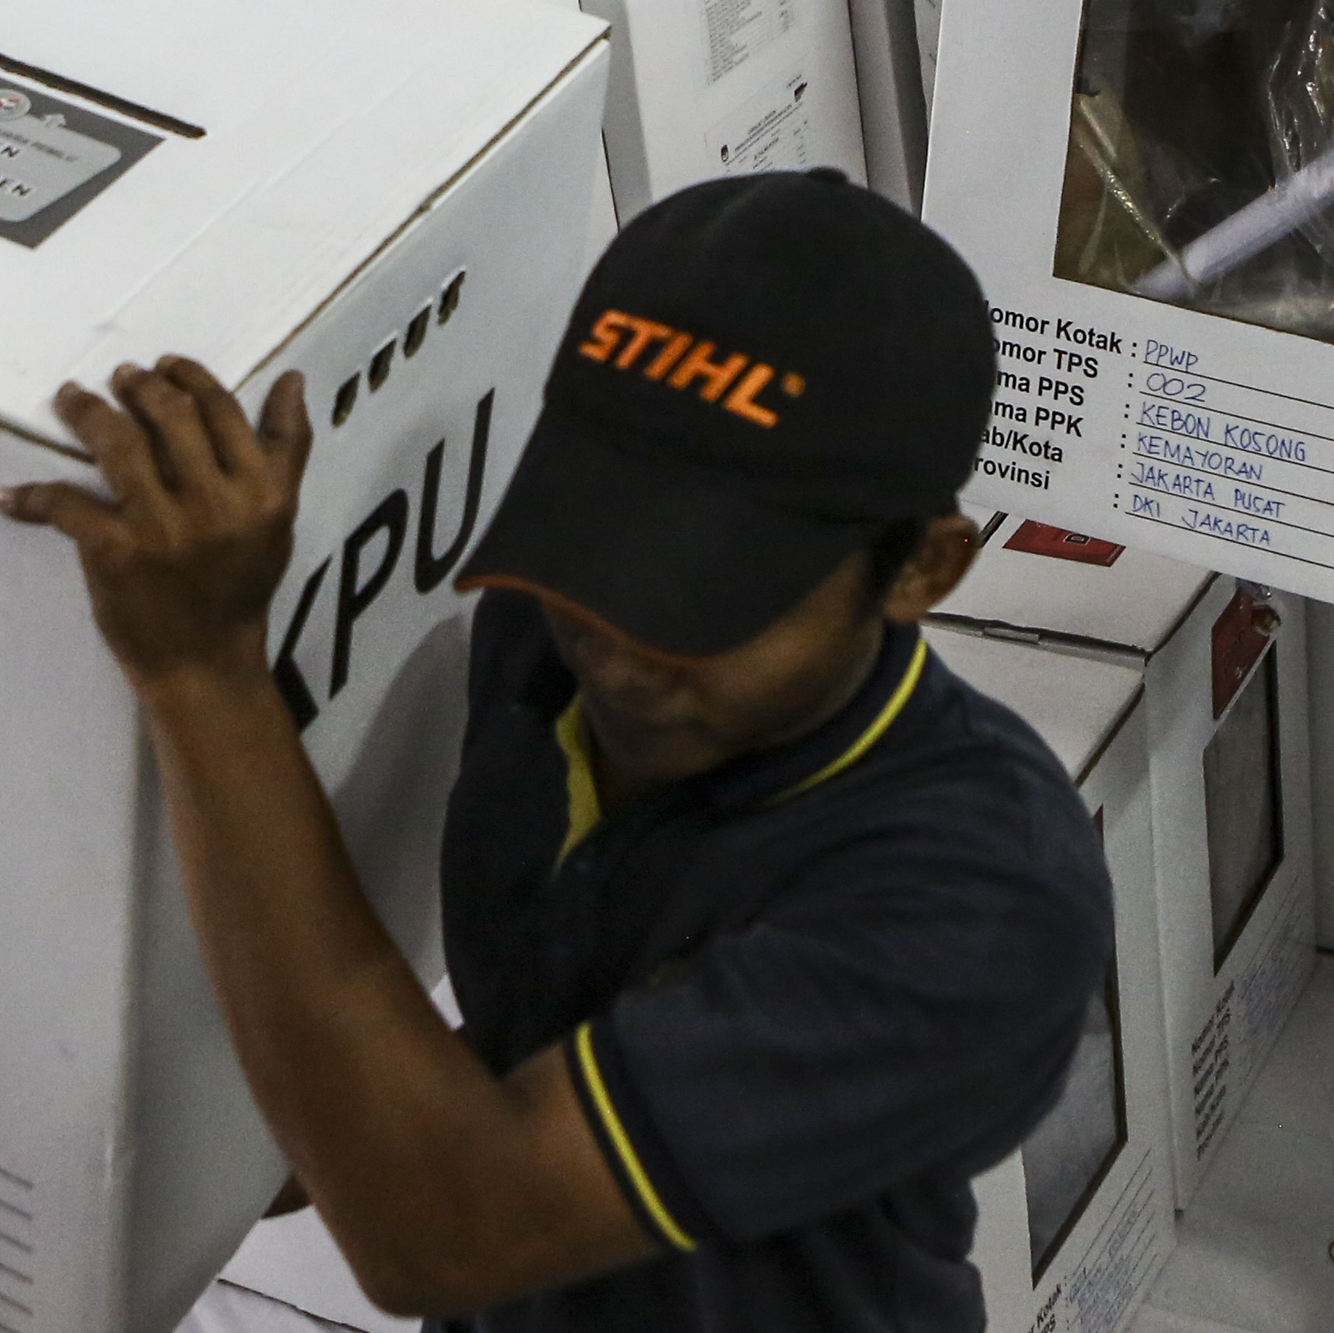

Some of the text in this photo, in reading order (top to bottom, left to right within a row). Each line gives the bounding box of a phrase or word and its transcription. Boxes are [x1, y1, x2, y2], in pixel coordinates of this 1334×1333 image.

[985, 300, 1123, 355] omor Kotak
[578, 308, 780, 429] STIHL
[993, 336, 1099, 378] omor TPS
[1144, 339, 1199, 373] PPWP
[997, 370, 1085, 406] ma PPS
[1146, 372, 1206, 402] 002
[989, 399, 1084, 438] ma PPK
[1140, 401, 1306, 462] KEBON KOSONG
[982, 425, 1063, 464] ab/Kota
[1137, 432, 1263, 481] KEMAYORAN
[975, 457, 1051, 490] rovinsi
[1131, 462, 1286, 518] JAKARTA PUSAT
[1132, 494, 1270, 545] DKI JAKARTA
